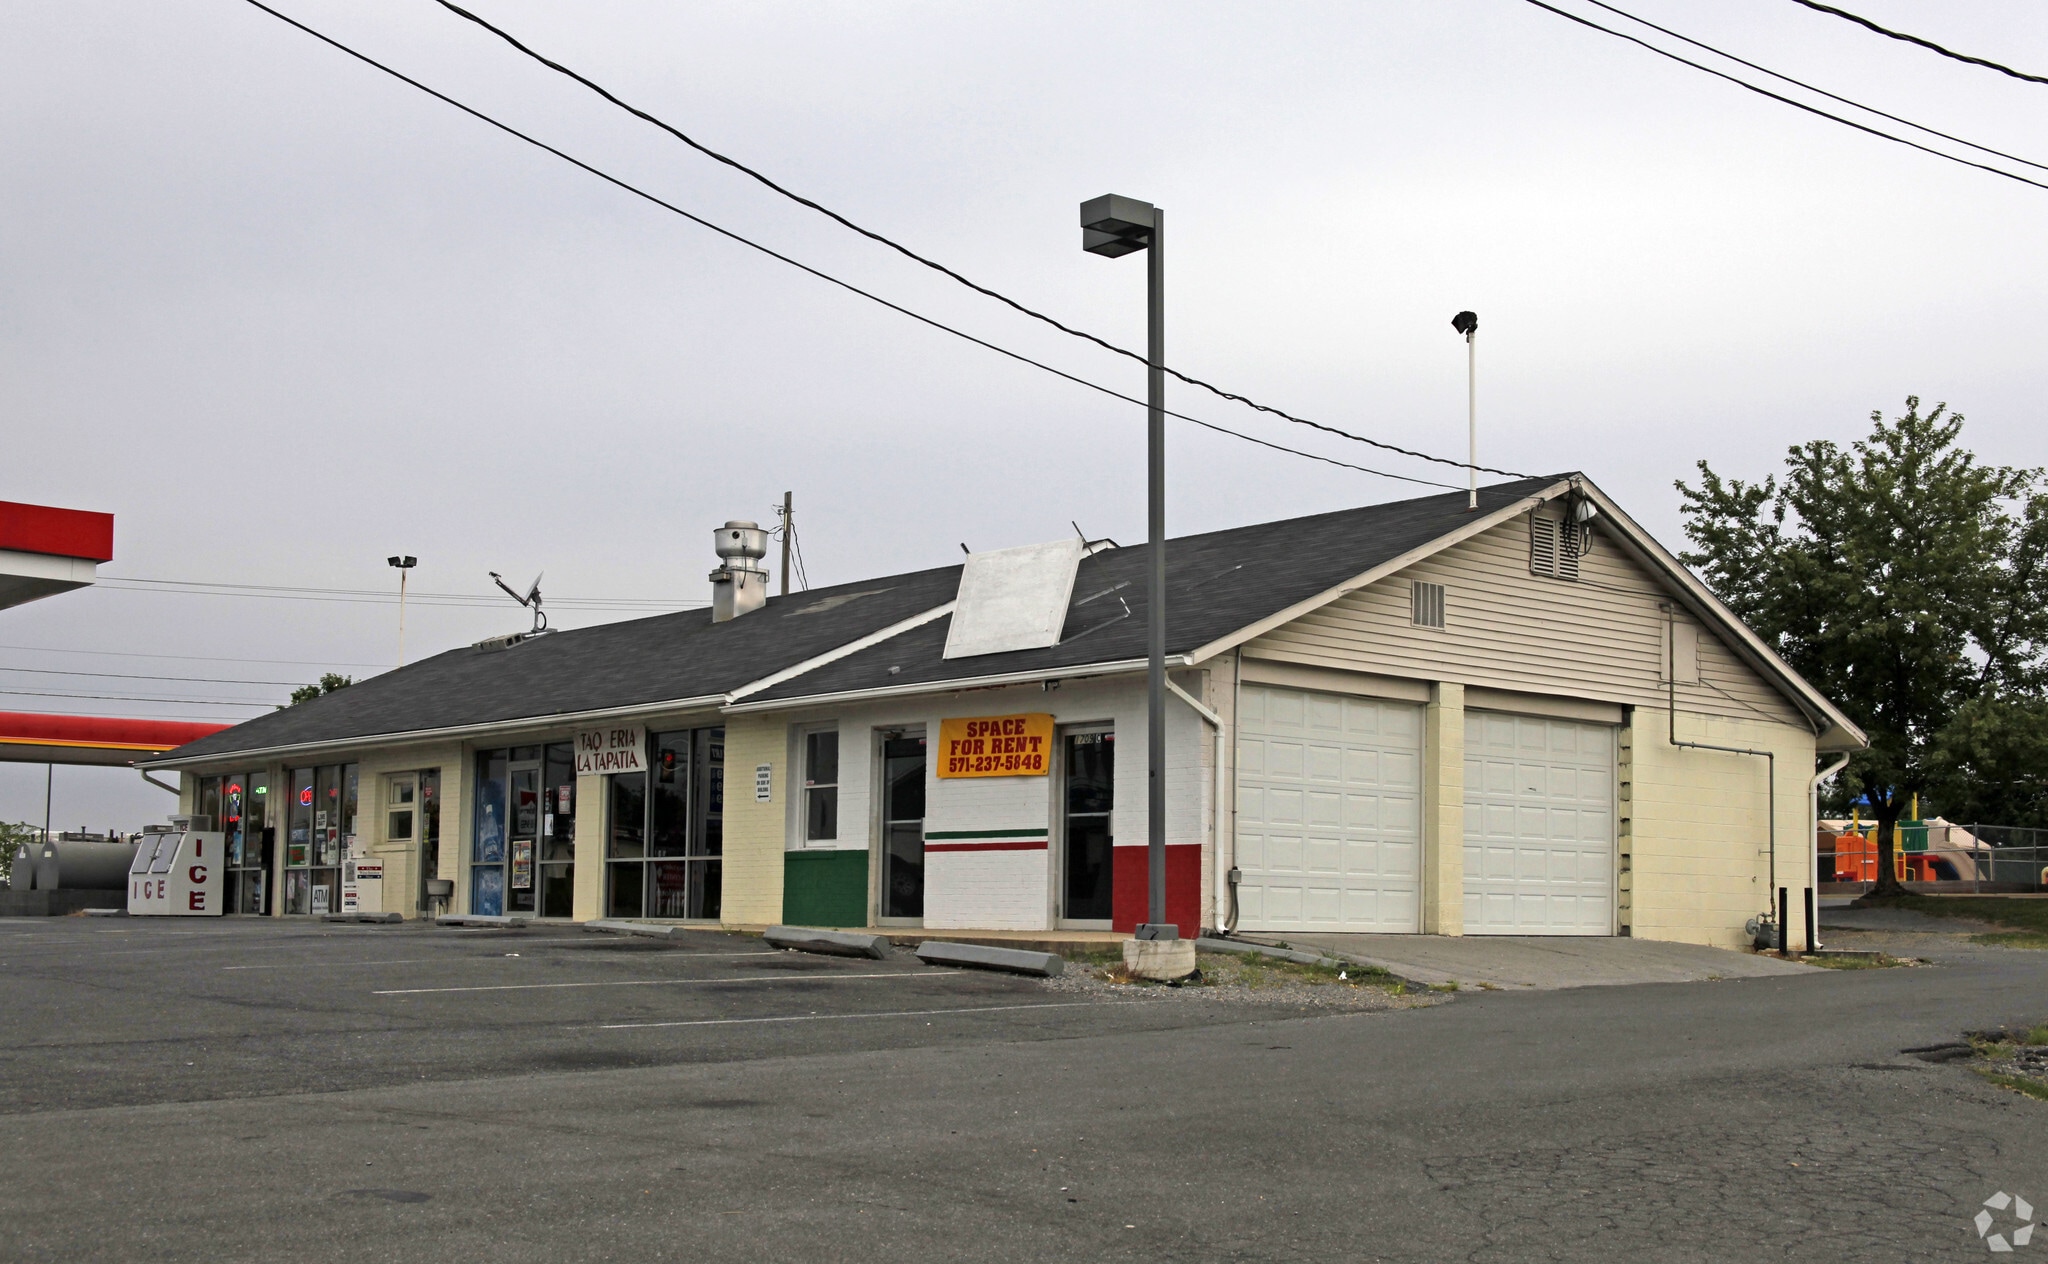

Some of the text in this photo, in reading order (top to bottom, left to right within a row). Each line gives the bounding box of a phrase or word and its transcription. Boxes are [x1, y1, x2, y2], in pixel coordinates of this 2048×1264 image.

[966, 718, 1026, 738] SPACE
[950, 736, 1042, 756] FOR RENT
[577, 750, 639, 772] LA TAPATIA
[949, 754, 1042, 773] 571-237-5848
[188, 838, 208, 911] ICE
[133, 879, 166, 899] ICE
[313, 889, 329, 903] ATM
